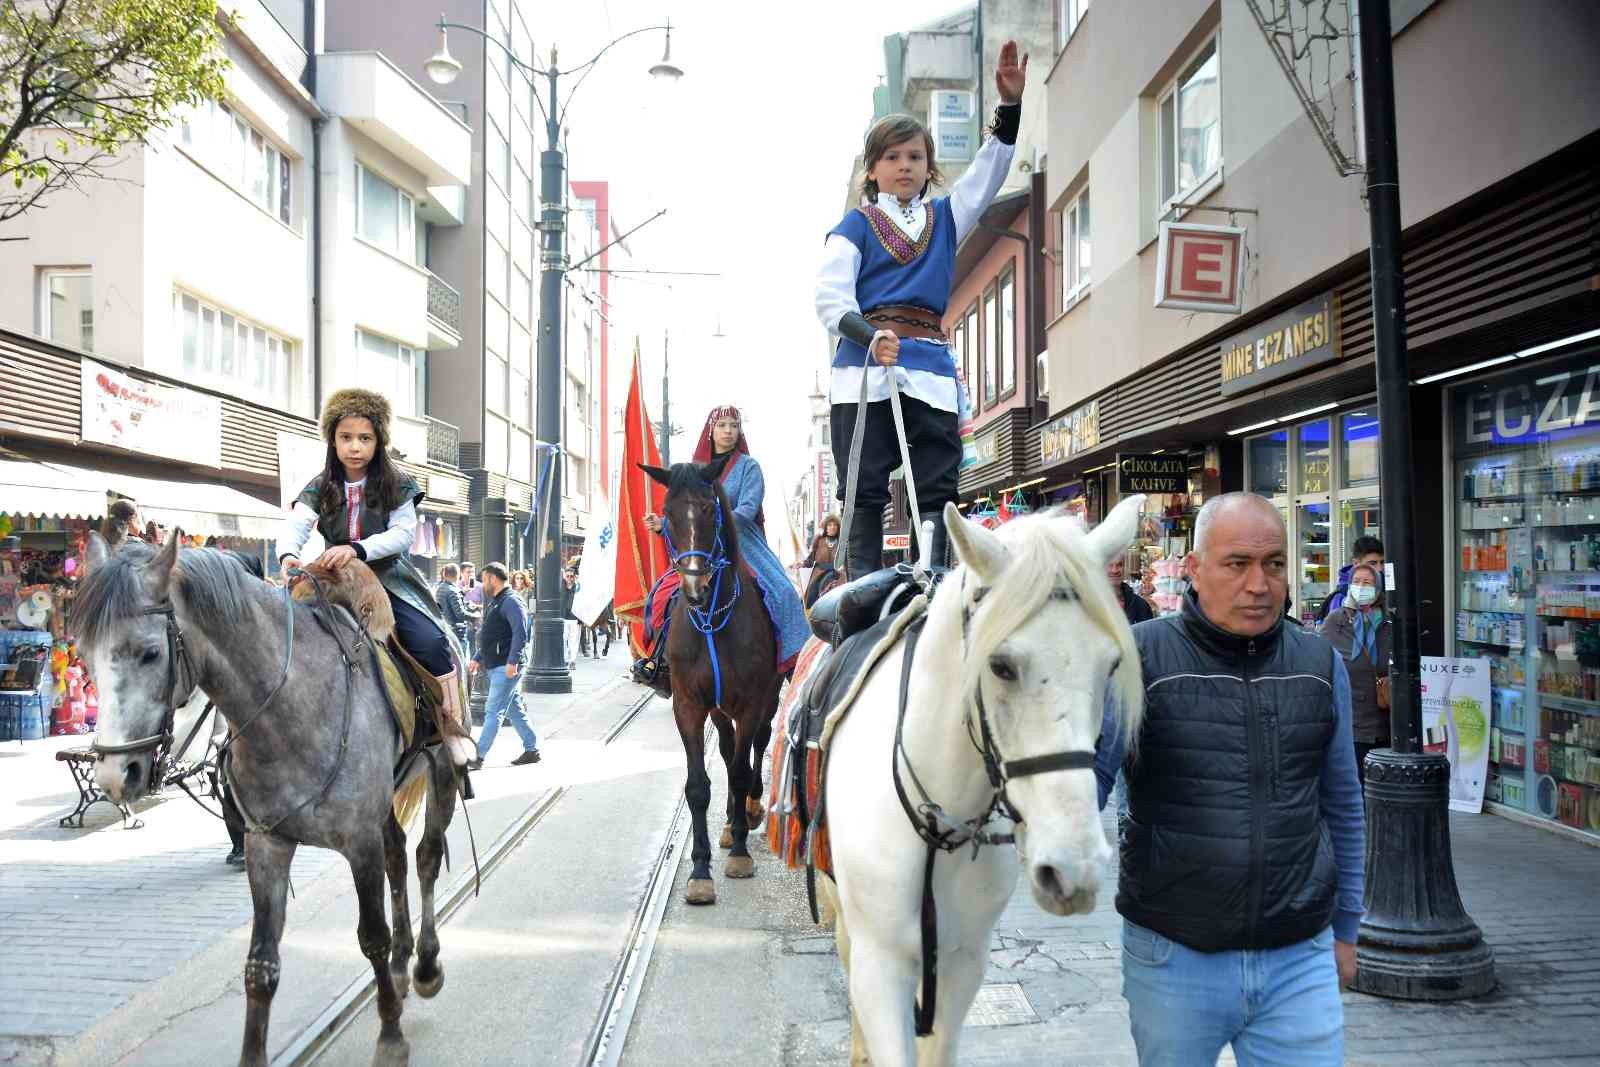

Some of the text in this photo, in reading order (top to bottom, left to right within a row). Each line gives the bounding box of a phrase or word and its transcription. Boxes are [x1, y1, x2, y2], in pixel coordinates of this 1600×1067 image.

[1180, 242, 1224, 293] E
[1222, 301, 1330, 384] MİNE ECZANESİ
[1121, 457, 1185, 475] ÇİKOLATA
[1130, 477, 1177, 491] KAHVE
[1420, 664, 1460, 674] NUXE
